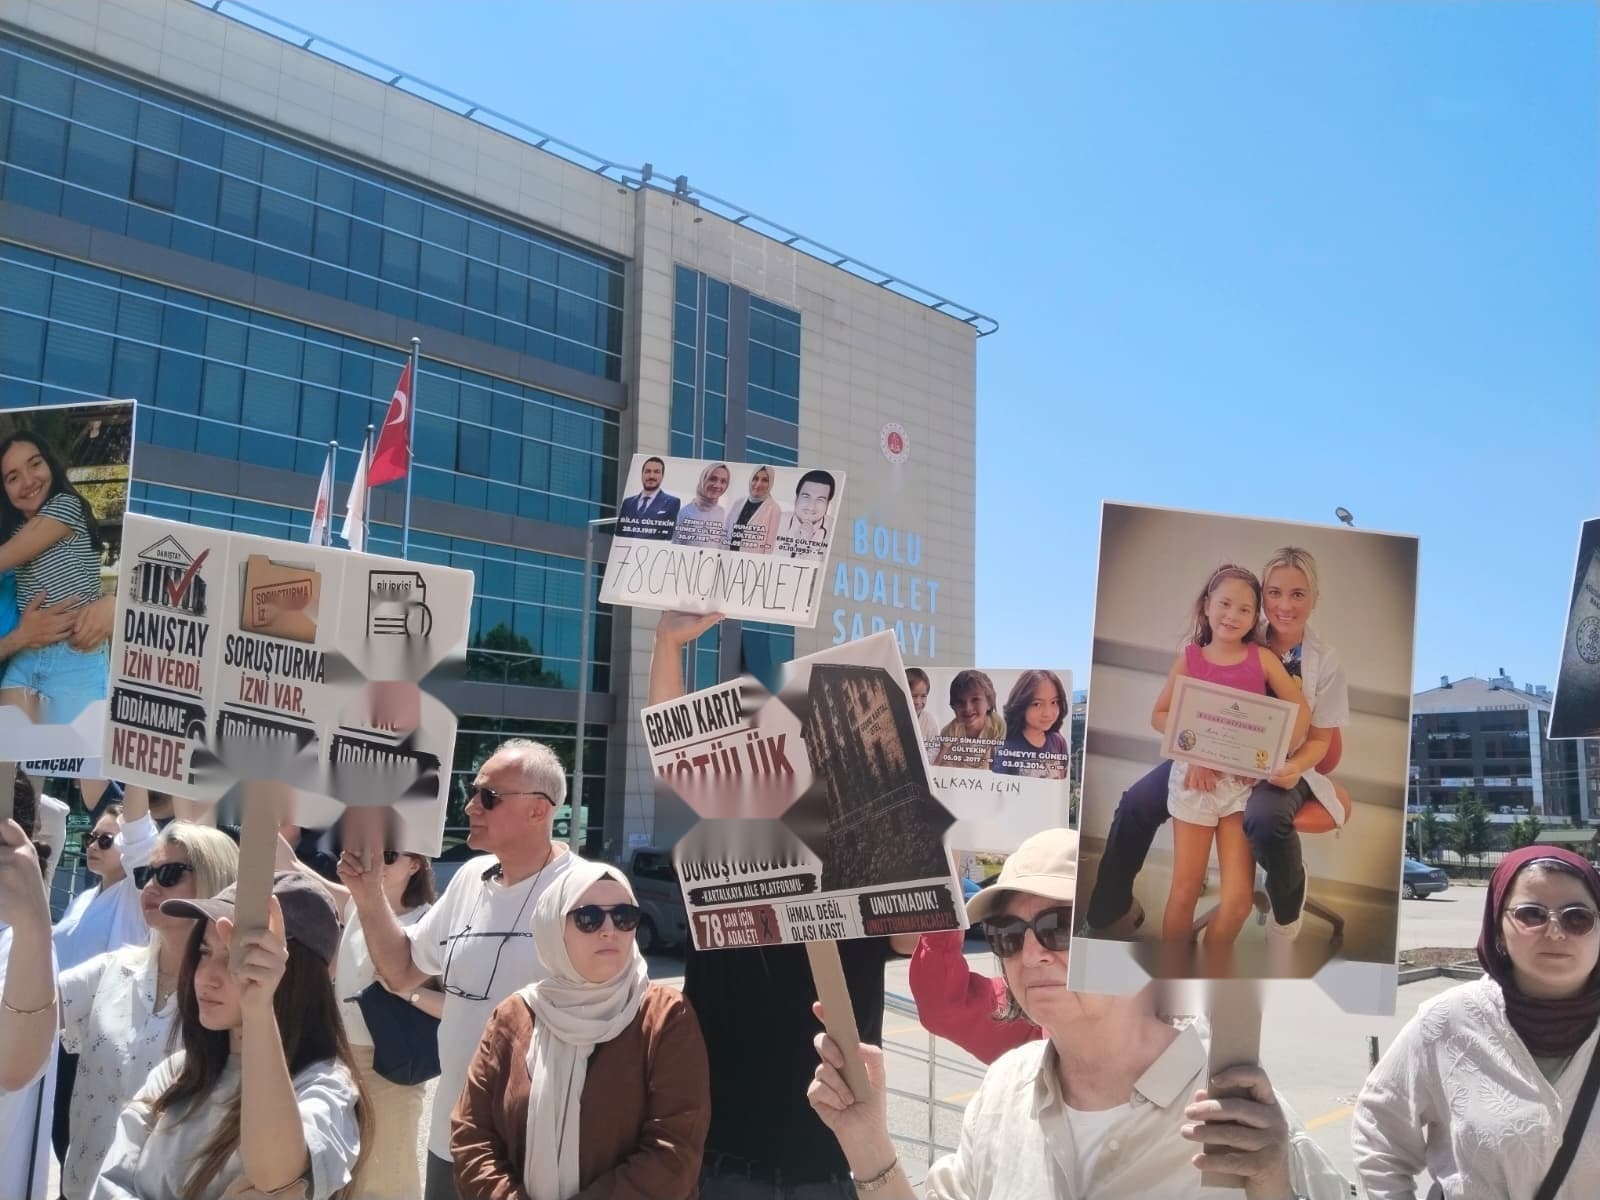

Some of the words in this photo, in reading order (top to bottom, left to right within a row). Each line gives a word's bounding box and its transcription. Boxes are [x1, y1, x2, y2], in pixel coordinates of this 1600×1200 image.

[641, 518, 675, 527] GÜLTEKİN
[795, 538, 828, 548] GÜLTEKİN
[853, 515, 922, 567] BOLU
[613, 545, 650, 594] 78
[650, 550, 692, 596] CAN
[834, 561, 940, 615] ADALET
[124, 608, 209, 658] DANIŞTAY
[122, 645, 153, 681] İZİN
[157, 656, 203, 693] VERDİ,
[224, 634, 326, 684] SORUŞTURMA
[116, 690, 186, 733] İDDİANAME
[239, 671, 270, 706] İZNİ
[274, 682, 306, 716] VAR,
[645, 703, 694, 747] GRAND
[693, 686, 744, 734] KARTA
[111, 727, 186, 781] NEREDE
[657, 732, 794, 776] ÖTÜLÜK
[951, 746, 986, 755] GÜLTEKİN
[998, 748, 1037, 760] SÜMEYYE
[1038, 750, 1068, 761] GÜNER
[743, 882, 760, 898] AİLE
[786, 905, 815, 923] İHMAL
[817, 899, 847, 921] DEĞİL,
[870, 890, 940, 916] UNUTMADIK!
[699, 913, 725, 947] 78
[723, 912, 740, 928] CAN
[738, 908, 755, 928] İÇİN
[727, 929, 760, 946] ADALET!
[791, 924, 817, 942] OLASI
[819, 921, 846, 940] KAST!
